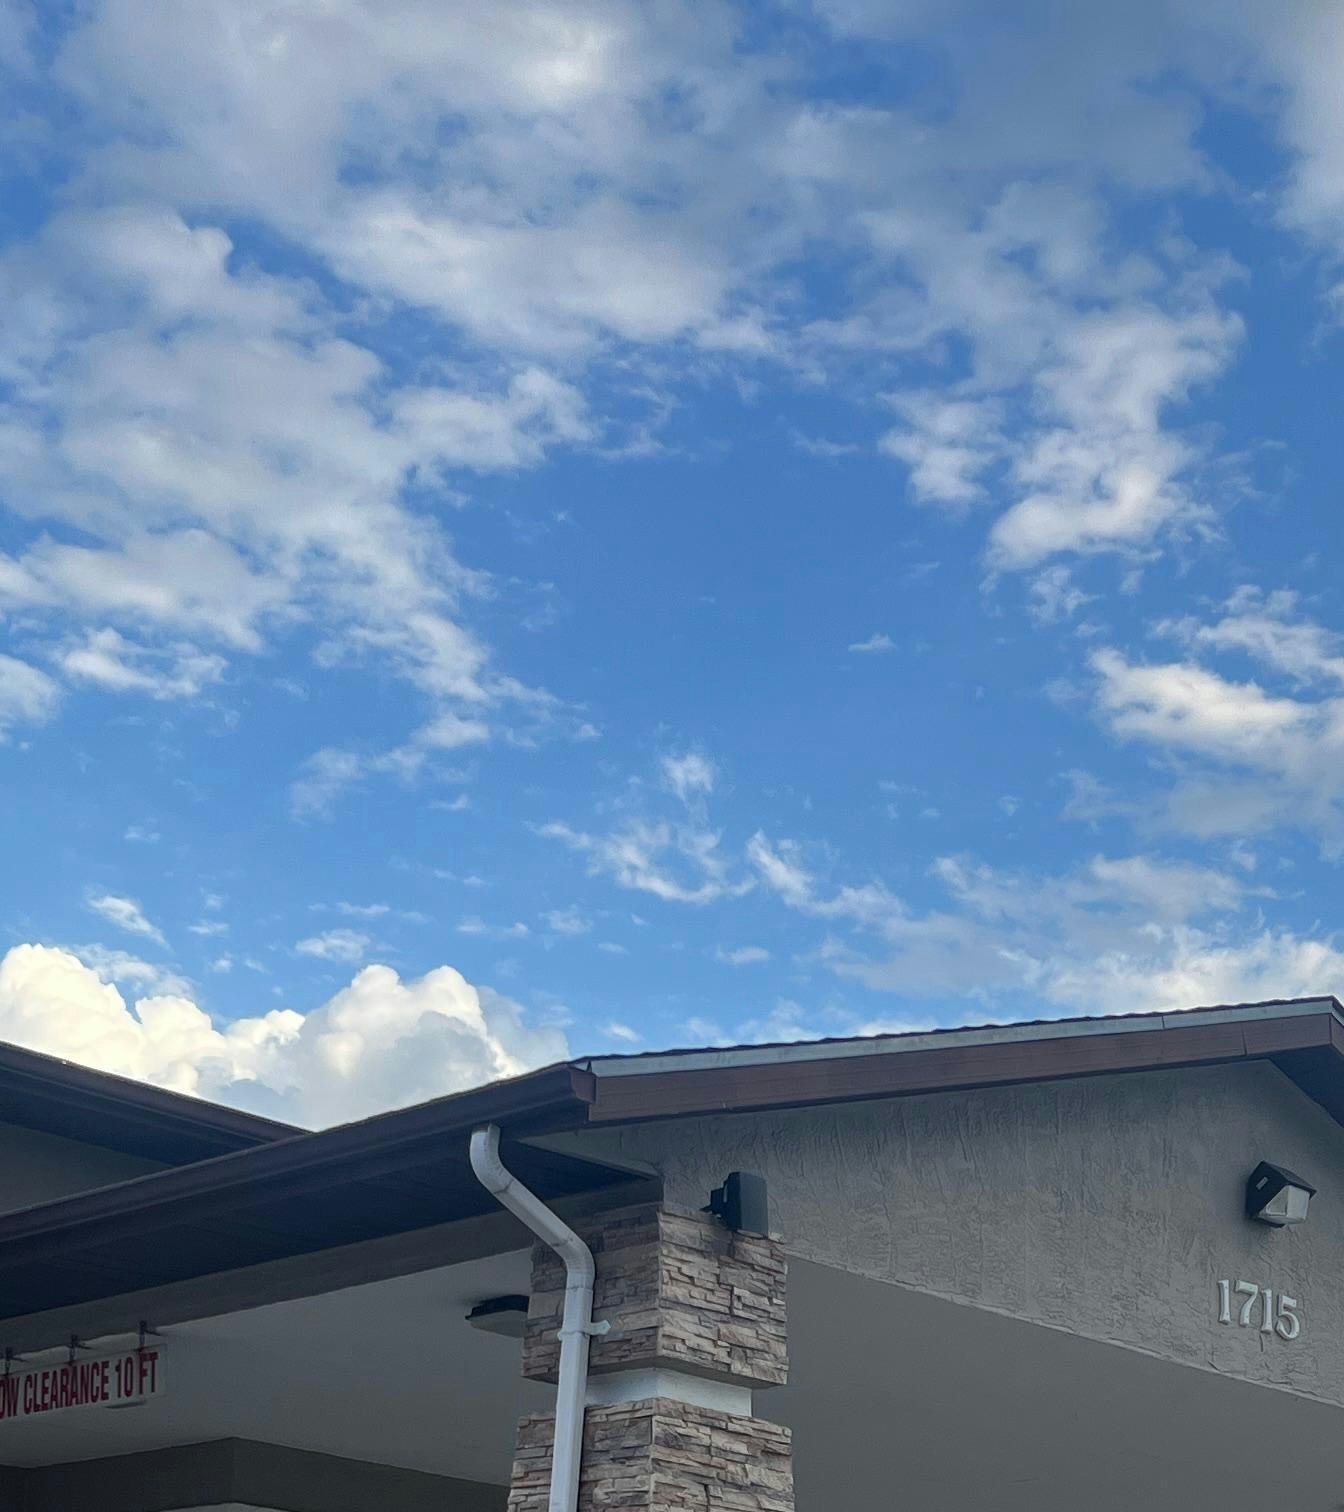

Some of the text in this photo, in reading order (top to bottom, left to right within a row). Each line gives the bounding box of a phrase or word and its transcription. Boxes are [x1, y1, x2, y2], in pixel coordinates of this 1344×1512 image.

[1217, 1279, 1300, 1340] 1715
[24, 1360, 110, 1415] CLEARANCE
[115, 1356, 134, 1398] 10
[139, 1351, 159, 1395] FT
